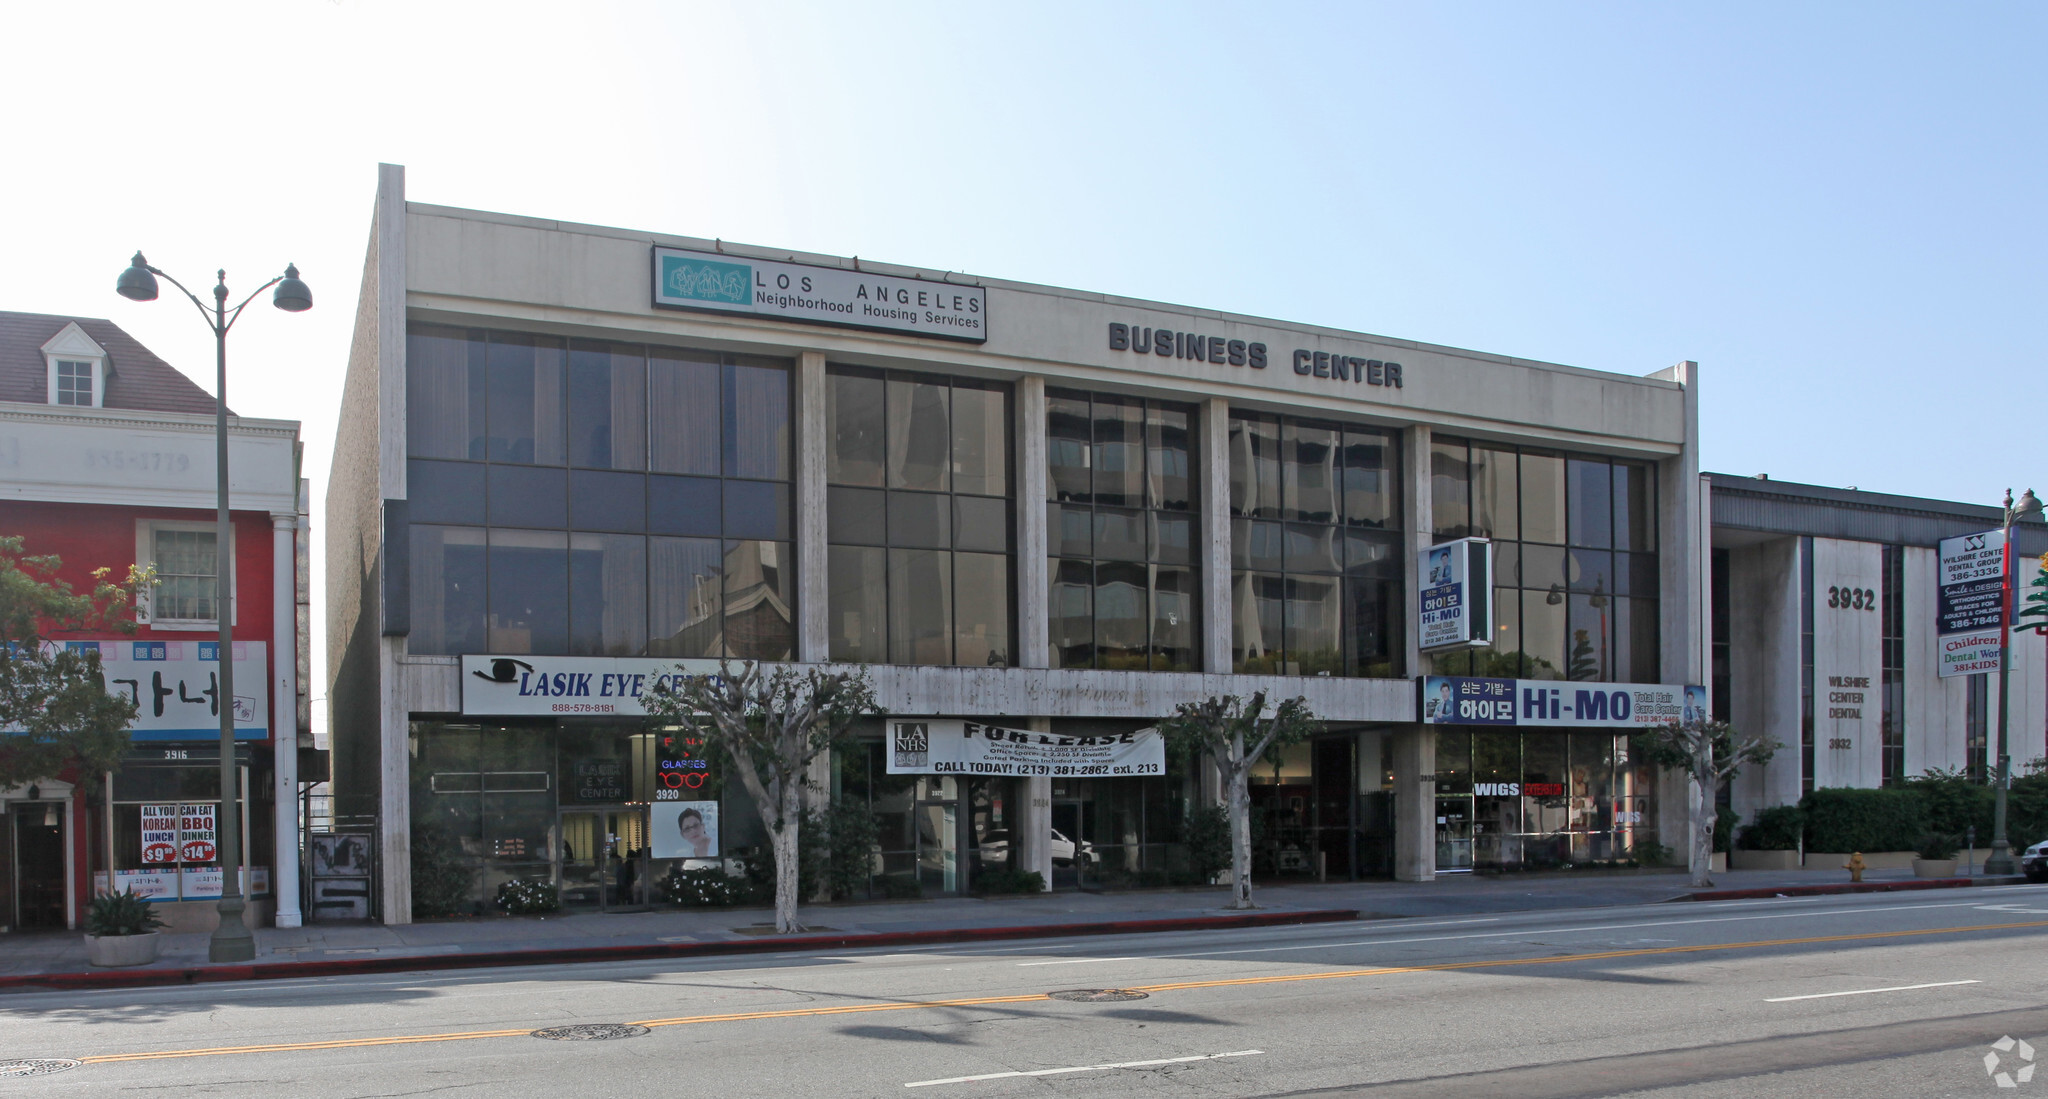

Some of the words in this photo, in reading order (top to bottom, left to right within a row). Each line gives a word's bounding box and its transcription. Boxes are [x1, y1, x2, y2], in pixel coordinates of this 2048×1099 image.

[756, 271, 812, 292] LOS
[856, 284, 979, 313] ANGELES
[756, 291, 853, 314] Neighborhood
[863, 304, 917, 324] Housing
[925, 311, 979, 329] Services
[1109, 322, 1267, 369] BUSINESS
[1293, 349, 1403, 388] CENTER
[1943, 553, 1977, 564] WILSHIRE
[1980, 548, 2003, 558] CENTE
[1948, 563, 1974, 572] DENTAL
[1976, 557, 2002, 567] GROUP
[1950, 566, 1999, 581] 386-3336
[1944, 584, 1968, 596] Smile
[1425, 594, 1457, 610] 하이모
[1828, 585, 1875, 611] 3932
[1949, 593, 2000, 604] ORTHODONTICS
[1944, 611, 1967, 619] ADULTS
[1974, 607, 2002, 615] CHILDRE
[1954, 603, 1980, 611] BRACES
[1422, 608, 1460, 624] Hi-MO
[1950, 615, 1999, 628] 386-7846
[1439, 627, 1458, 635] Center
[1946, 637, 2001, 651] Children'
[1944, 651, 1976, 663] Dental
[1954, 660, 1998, 672] 381-KIDS
[519, 672, 592, 697] LASIK
[600, 673, 645, 697] EYE
[1461, 682, 1480, 694] 심는
[1828, 676, 1870, 688] WILSHIRE
[1634, 692, 1654, 702] Total
[1656, 692, 1673, 703] Hair
[1829, 692, 1864, 703] CENTER
[552, 704, 614, 712] 888-578-8181
[1460, 700, 1513, 720] 하이모
[1523, 687, 1630, 721] Hi-MO
[1634, 703, 1654, 714] Care
[1655, 703, 1682, 714] Center
[1829, 708, 1862, 719] DENTAL
[896, 724, 926, 740] LA
[964, 722, 1028, 744] FOR
[1039, 732, 1136, 746] LEASE
[896, 740, 927, 751] NHS
[1828, 738, 1851, 749] 3932
[165, 750, 187, 759] 3916
[935, 762, 966, 772] CALL
[969, 762, 1012, 773] TODAY!
[1017, 764, 1049, 775] (213)
[1053, 765, 1109, 775] 381-2862
[1113, 764, 1133, 774] ext.
[1137, 764, 1158, 773] 213
[586, 776, 614, 786] EYE
[580, 788, 621, 798] CENTER
[656, 789, 679, 799] 3920
[1474, 783, 1519, 796] WIGS
[143, 806, 157, 816] ALL
[159, 806, 175, 816] YOU
[180, 806, 196, 815] CAN
[199, 806, 212, 815] EAT
[1615, 811, 1641, 823] WIGS
[143, 818, 176, 830] KOREAN
[182, 817, 213, 830] BBQ
[144, 832, 174, 842] LUNCH
[182, 831, 214, 840] DINNER
